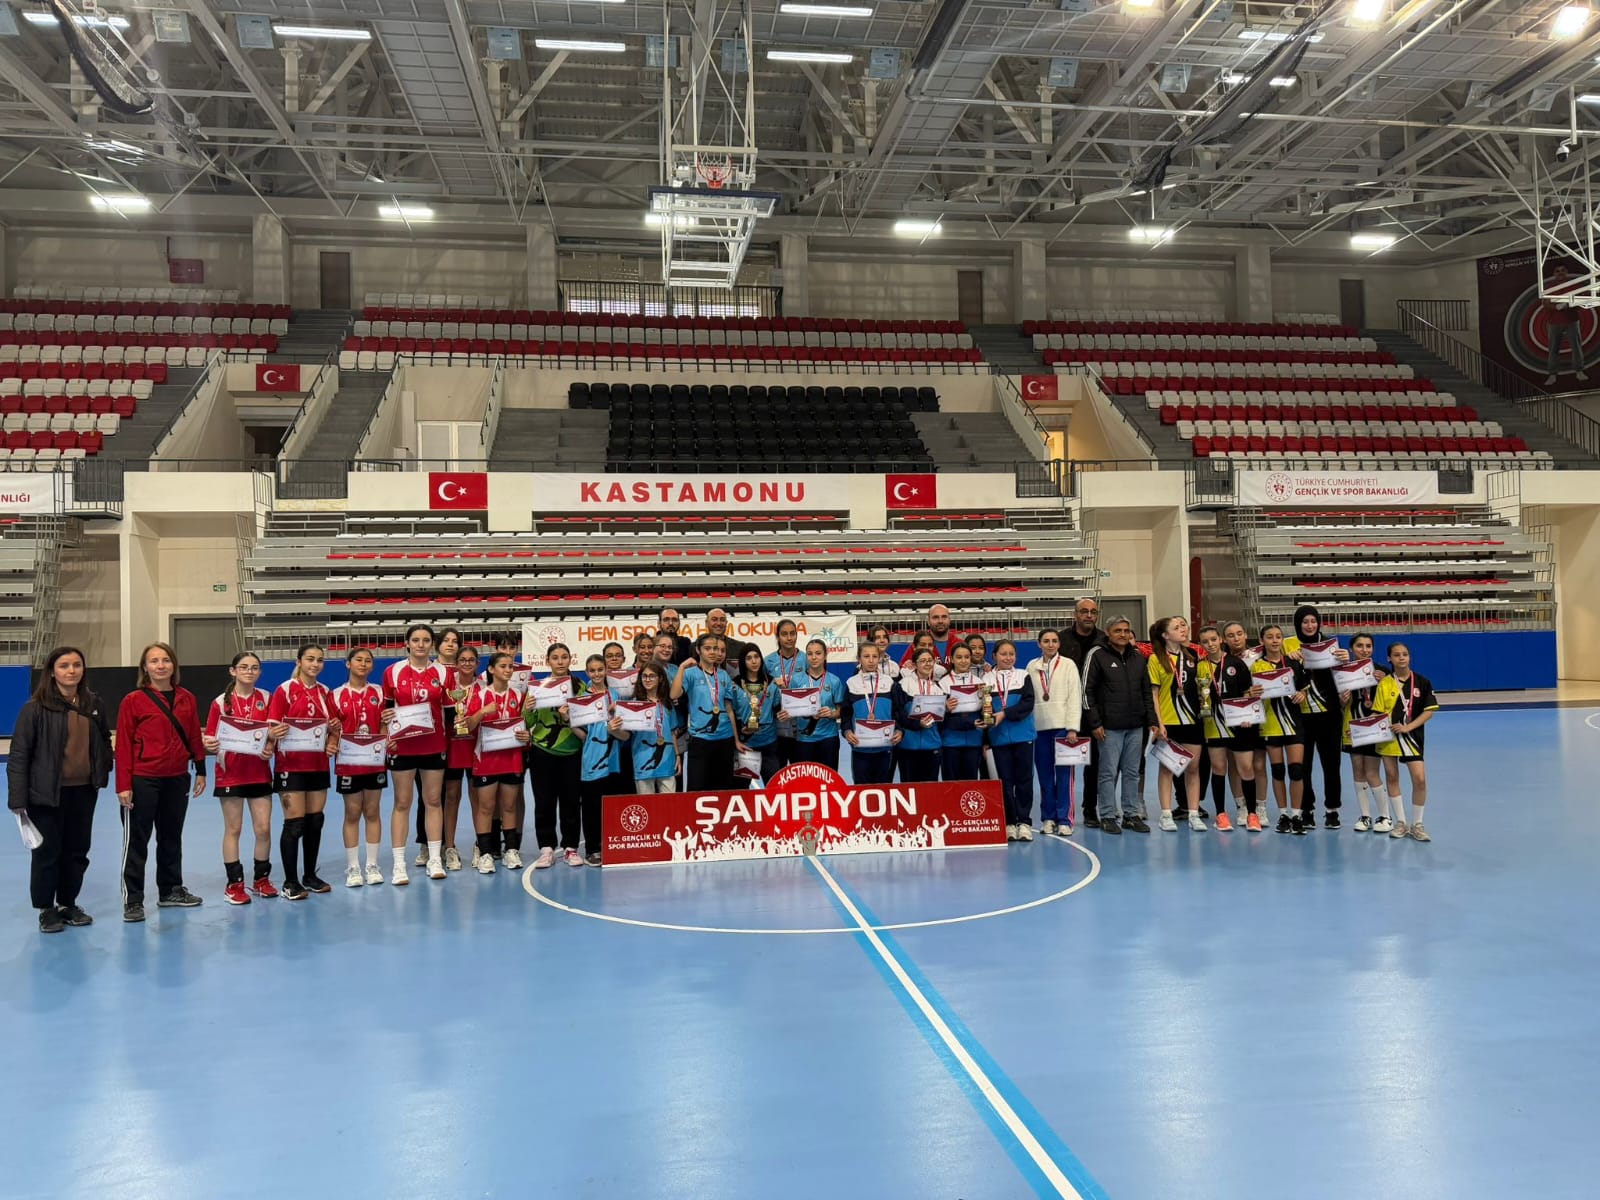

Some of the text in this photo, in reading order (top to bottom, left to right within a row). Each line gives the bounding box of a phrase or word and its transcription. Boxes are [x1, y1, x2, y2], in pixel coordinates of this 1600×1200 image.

[1295, 477, 1378, 486] TÜRKİYE CUMHURİYETİ
[580, 482, 805, 503] KASTAMONU
[1295, 486, 1409, 497] GENÇLİK VE SPOR BAKANLIĞI
[578, 626, 618, 642] HEM
[695, 784, 918, 832] ŞAMPİYON
[963, 818, 989, 826] GENÇLİK
[968, 825, 1000, 833] BAKANLIĞI
[621, 834, 651, 842] GENÇLİK
